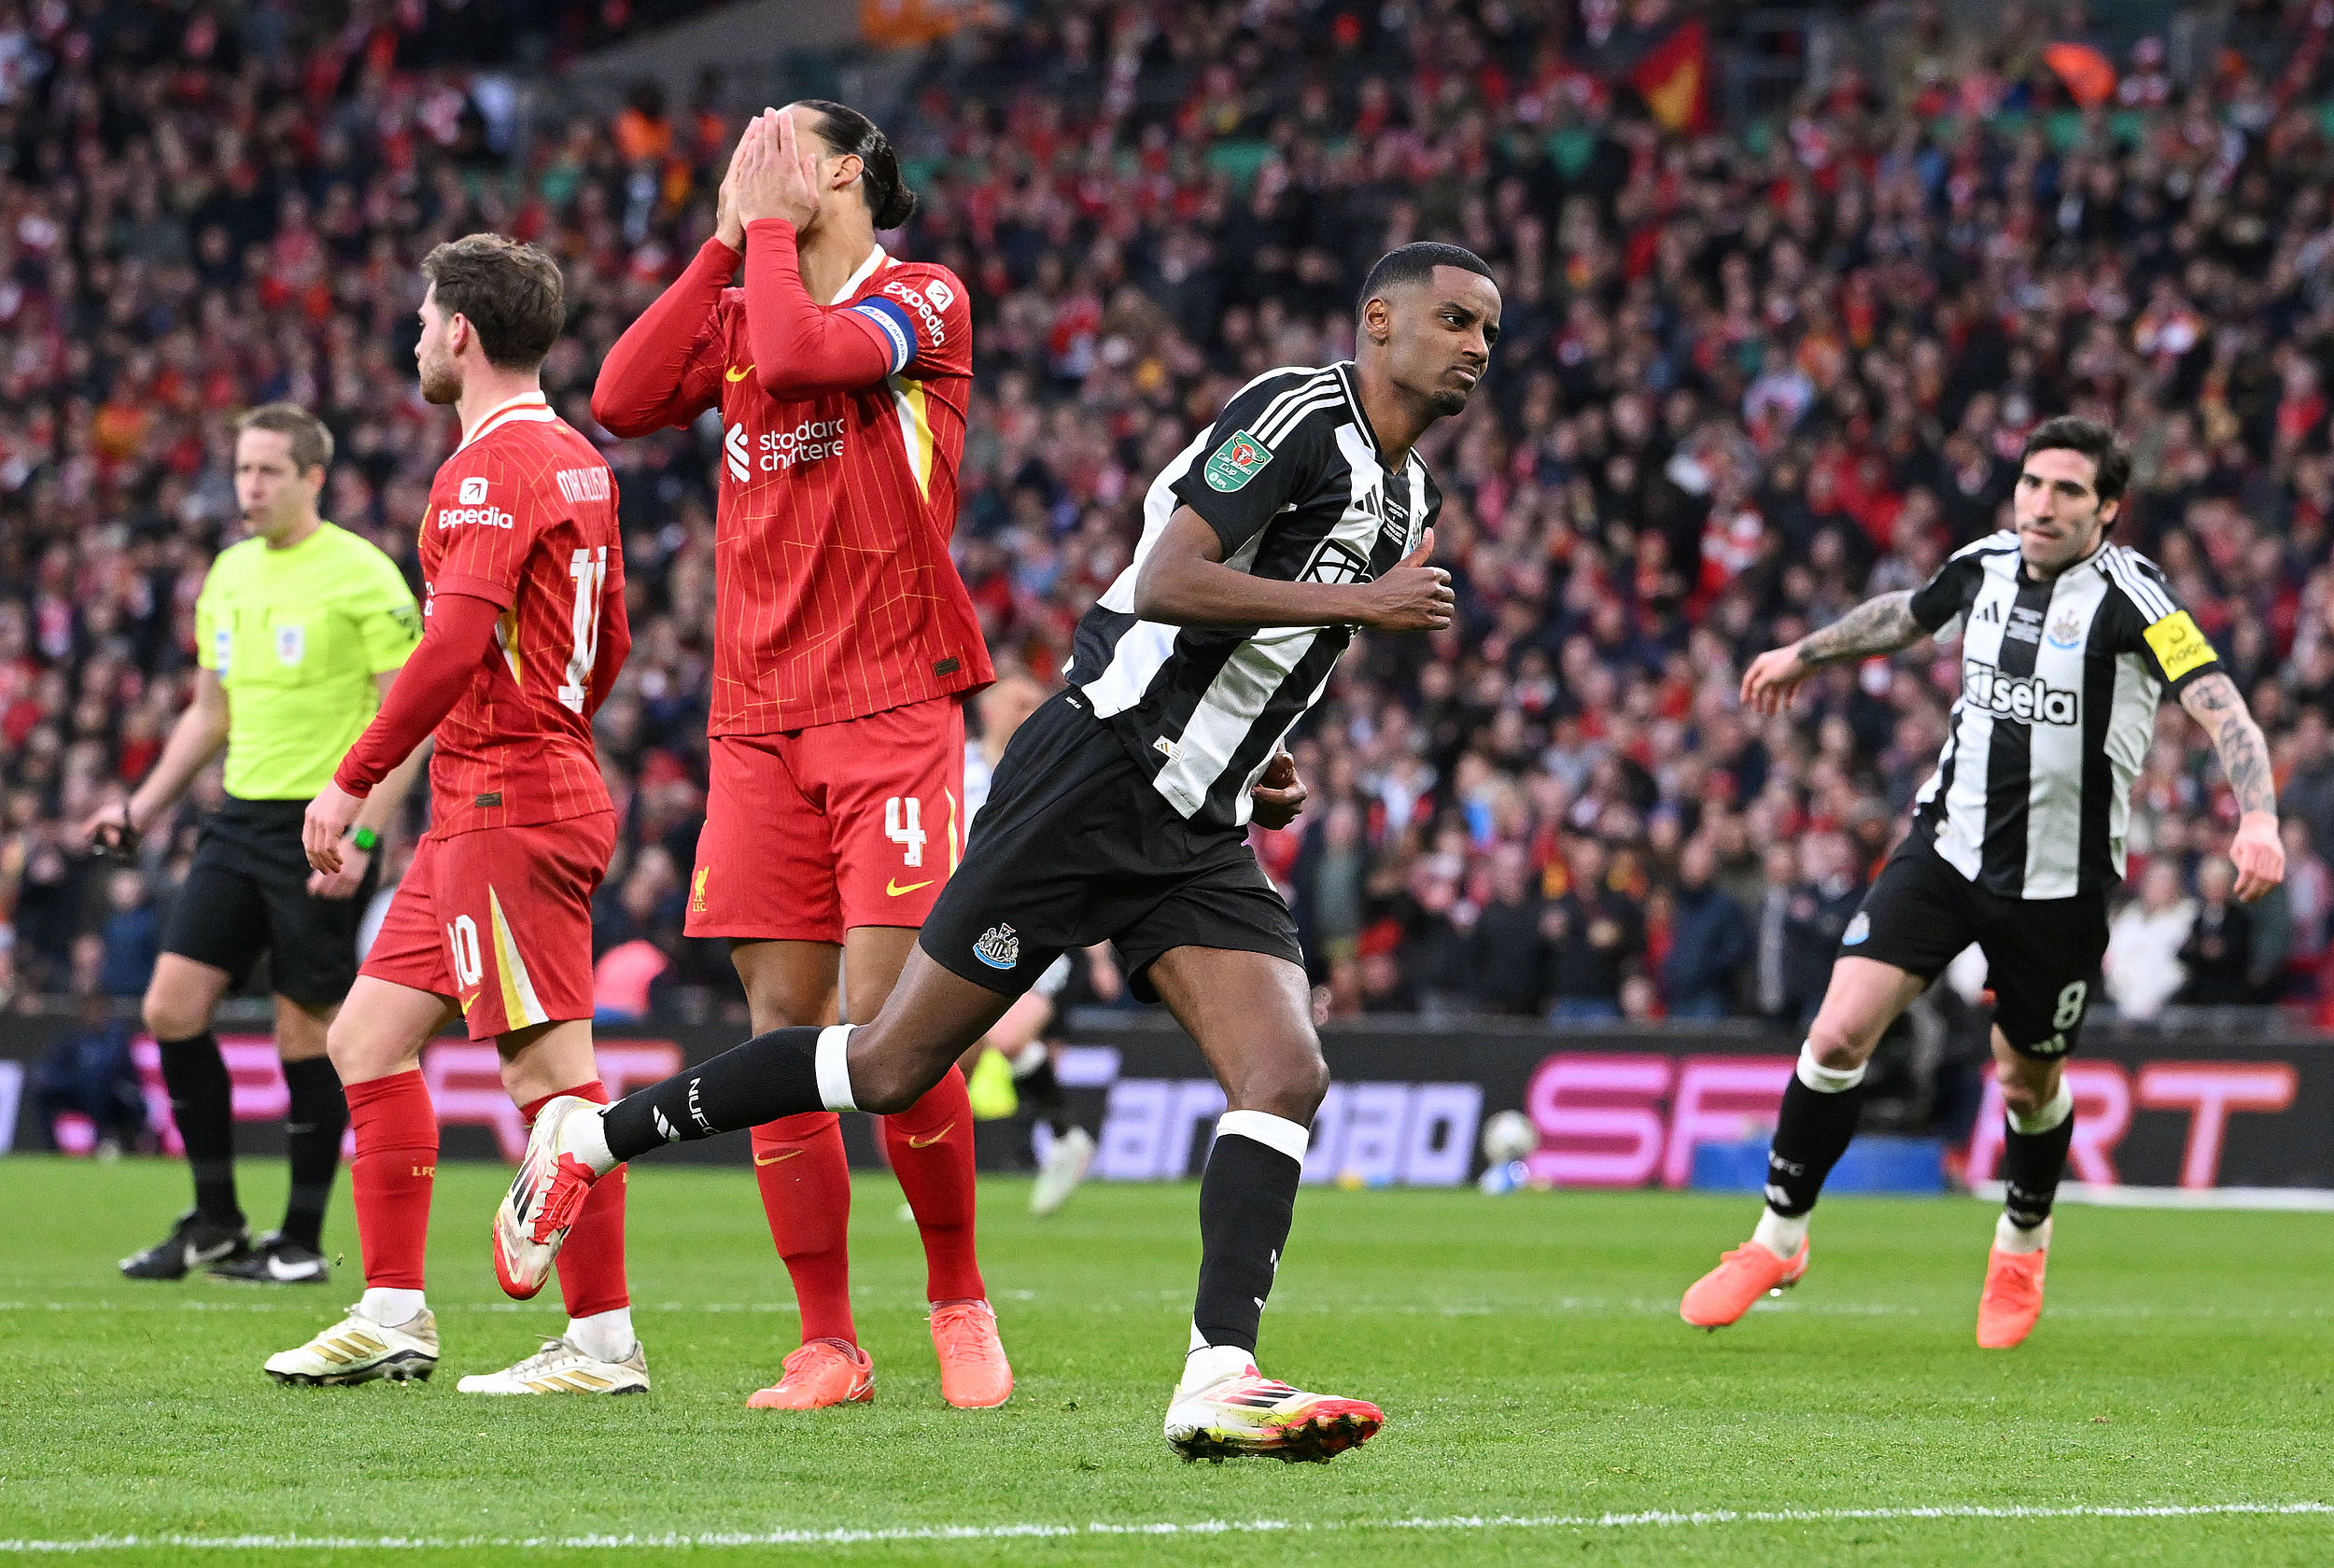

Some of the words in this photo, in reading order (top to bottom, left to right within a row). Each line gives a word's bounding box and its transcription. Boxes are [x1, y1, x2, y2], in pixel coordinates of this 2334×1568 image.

[883, 281, 945, 347] Expedia
[759, 417, 845, 451] stadar
[759, 440, 845, 471] chrtere
[1216, 452, 1253, 476] Carabao
[1218, 463, 1238, 476] Cup
[1990, 678, 2077, 725] sela
[885, 796, 927, 868] 4
[693, 902, 708, 913] LFC
[2052, 980, 2088, 1030] 8
